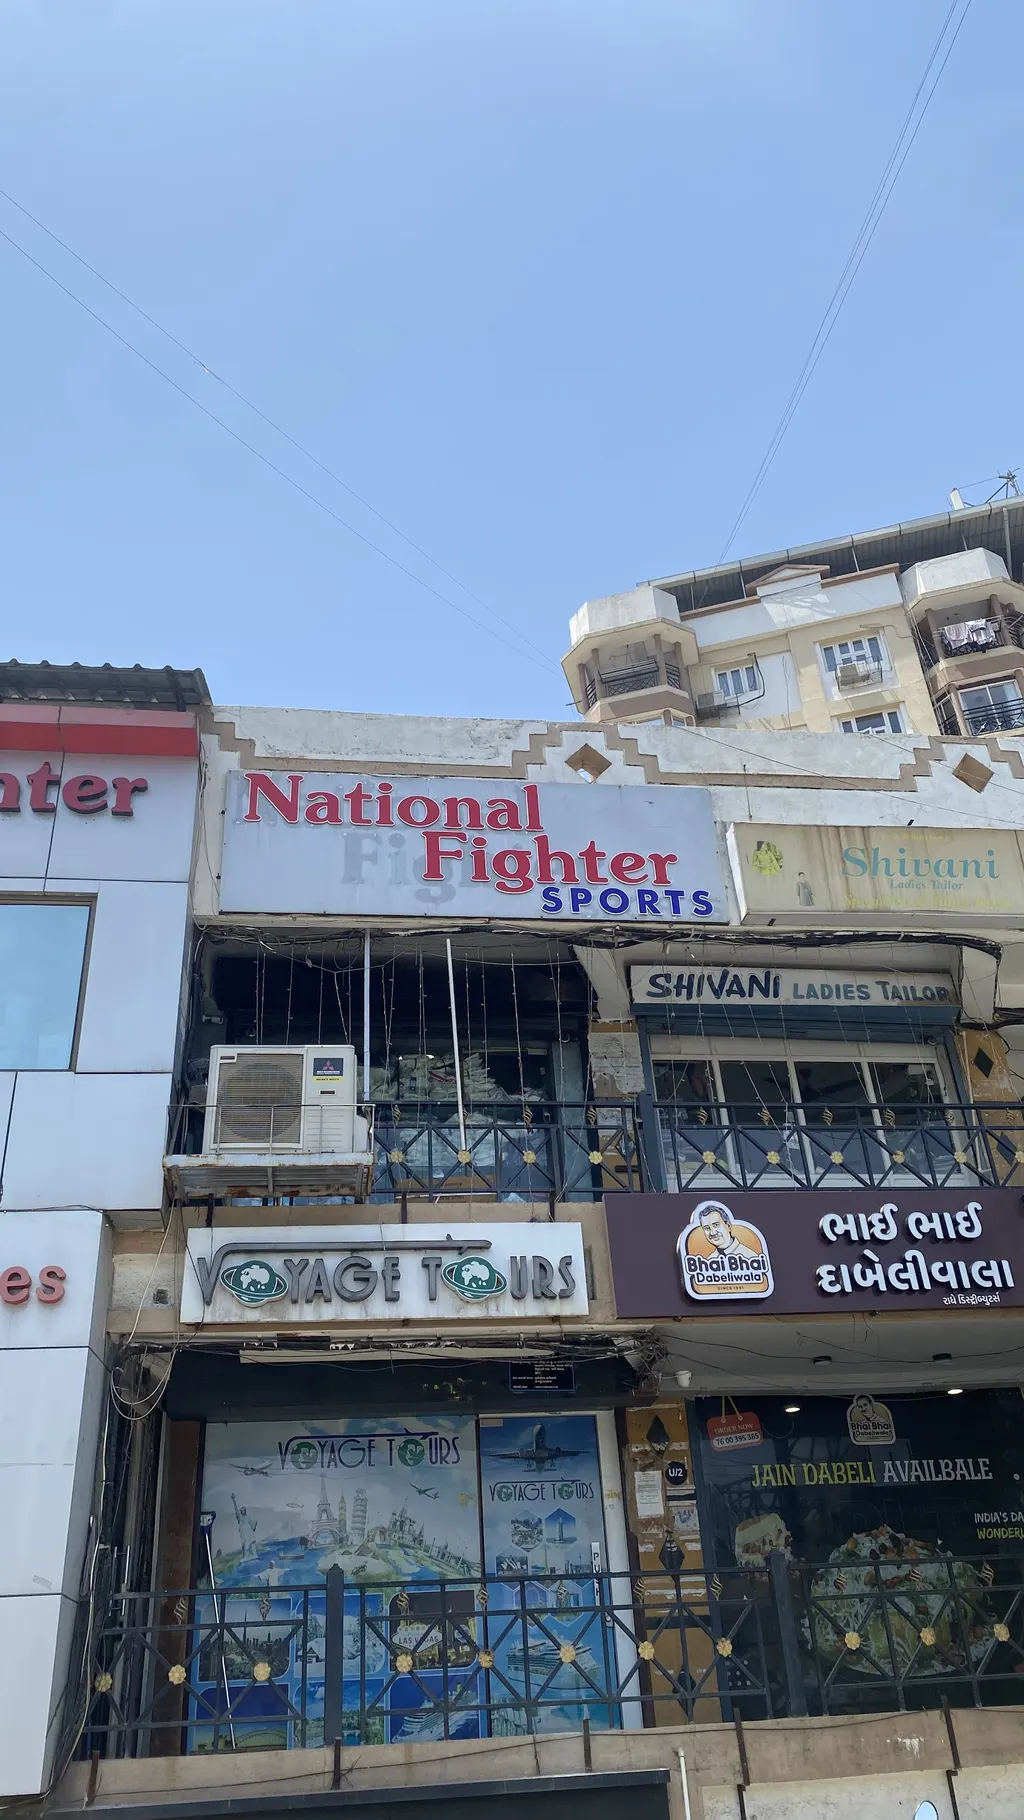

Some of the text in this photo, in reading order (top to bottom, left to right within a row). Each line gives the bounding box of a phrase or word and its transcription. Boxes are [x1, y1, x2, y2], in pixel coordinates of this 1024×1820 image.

[243, 772, 544, 832] National
[421, 830, 679, 894] Fighter
[842, 847, 1001, 879] Shivani
[889, 878, 964, 892] Ladies Tailor
[541, 886, 715, 918] SPORTS
[793, 982, 871, 1001] LADIES
[819, 1201, 984, 1242] ભાઈ ભાઈ
[686, 1255, 767, 1273] Bhai Bhai
[816, 1249, 1016, 1295] દાબેલીવાલા
[696, 1272, 761, 1283] Dabeliwala
[714, 1423, 754, 1435] ORDER NOW
[851, 1420, 891, 1431] Bhai Bhai
[751, 1458, 994, 1488] JAIN DABELI AVAILBALE
[974, 1511, 1009, 1524] INDIA'S
